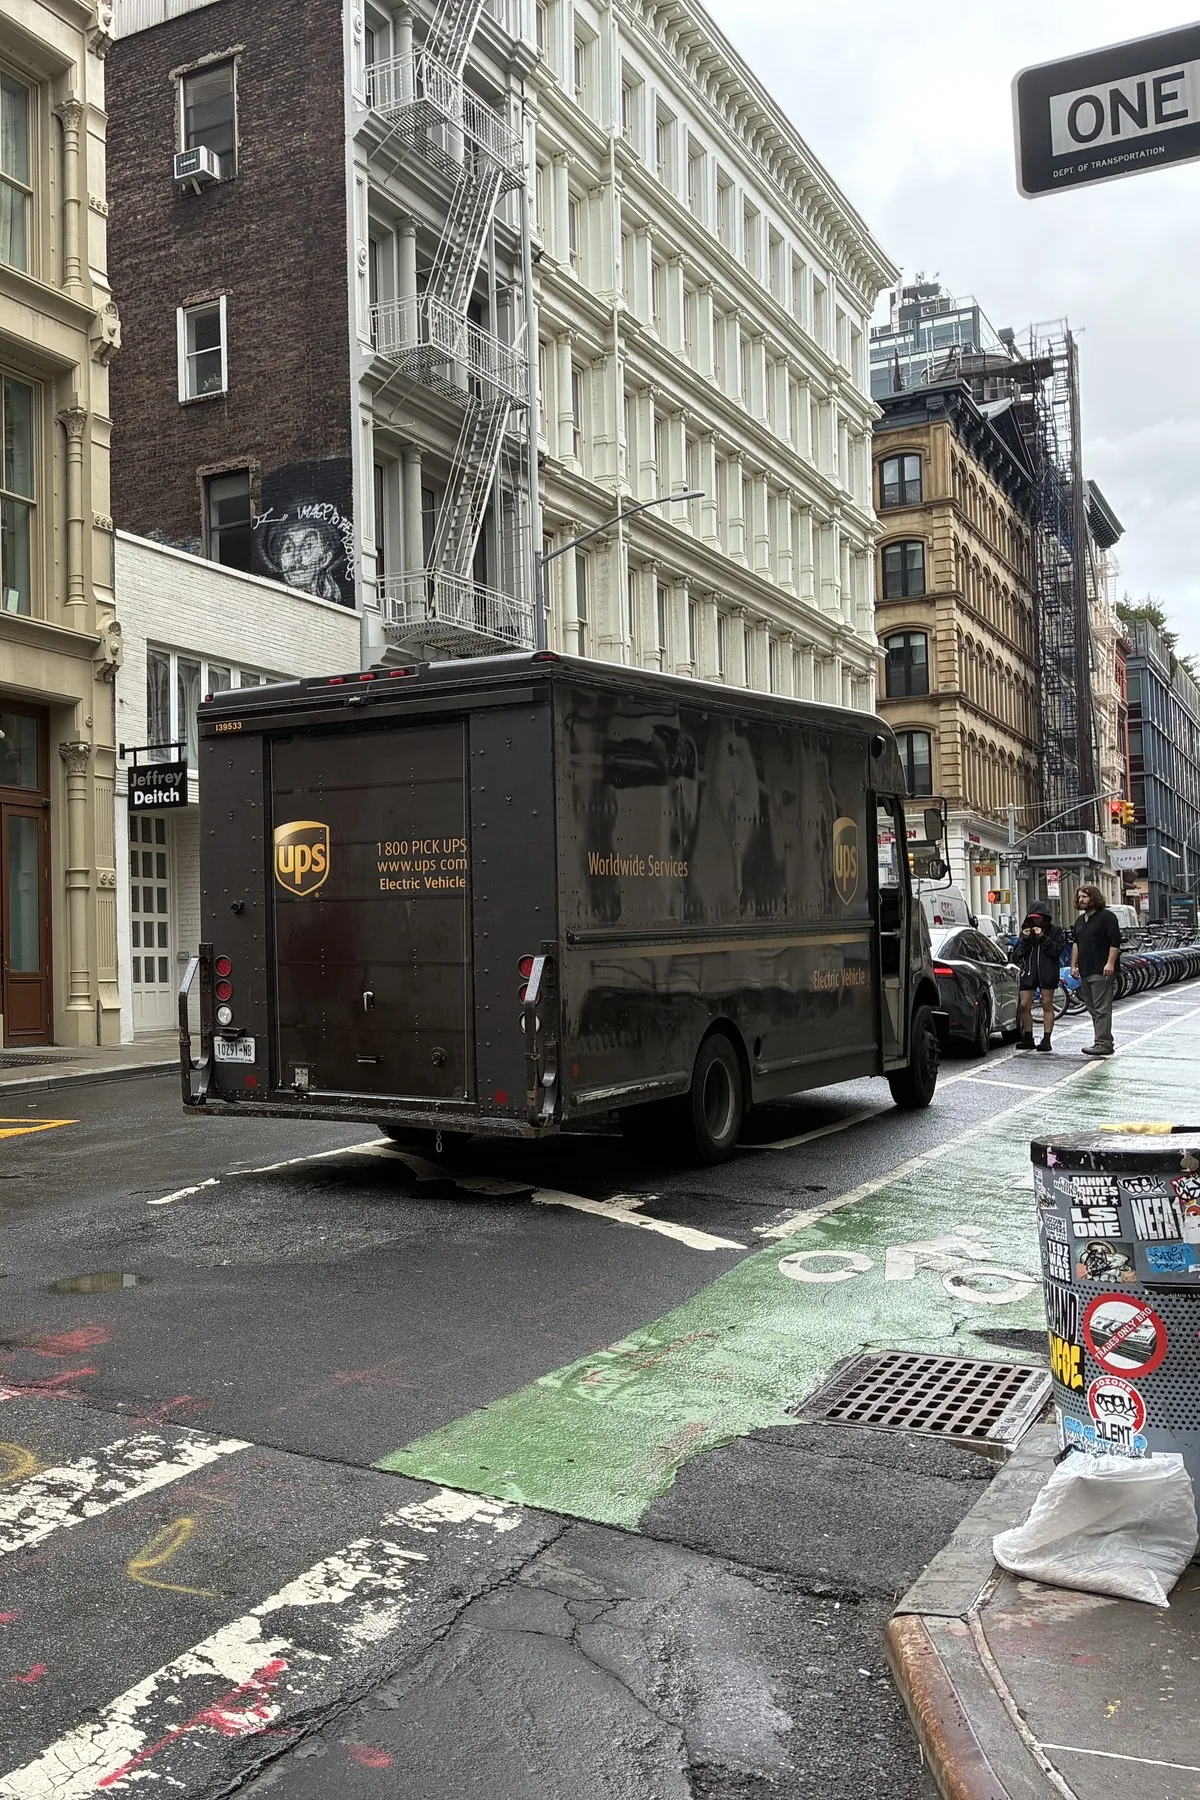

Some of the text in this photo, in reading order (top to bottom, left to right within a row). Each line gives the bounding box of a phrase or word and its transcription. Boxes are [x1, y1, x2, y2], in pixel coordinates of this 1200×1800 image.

[1067, 70, 1189, 144] ONE
[1053, 146, 1165, 178] DEPT. OF TRANSPORTATION
[216, 722, 242, 732] 139533
[130, 770, 183, 787] Jeffrey
[134, 787, 180, 805] Deitch
[412, 840, 440, 854] PICK
[442, 838, 467, 854] UPS
[278, 844, 326, 884] ups
[588, 852, 688, 877] Worldwide Services
[835, 844, 858, 892] ups
[380, 876, 466, 890] Electric Vehicle
[813, 967, 866, 990] Electric Vehicle
[1072, 1176, 1113, 1186] DANNY
[1082, 1196, 1108, 1206] NYC
[1070, 1207, 1118, 1222] LS
[1072, 1222, 1122, 1237] ONE
[1048, 1240, 1069, 1258] TEDZ
[1049, 1252, 1070, 1269] WAS
[1050, 1265, 1071, 1282] HERE
[1094, 1307, 1152, 1360] TRADES ONLY BRO
[1095, 1379, 1132, 1394] JOZONE
[1096, 1420, 1132, 1446] SILENT
